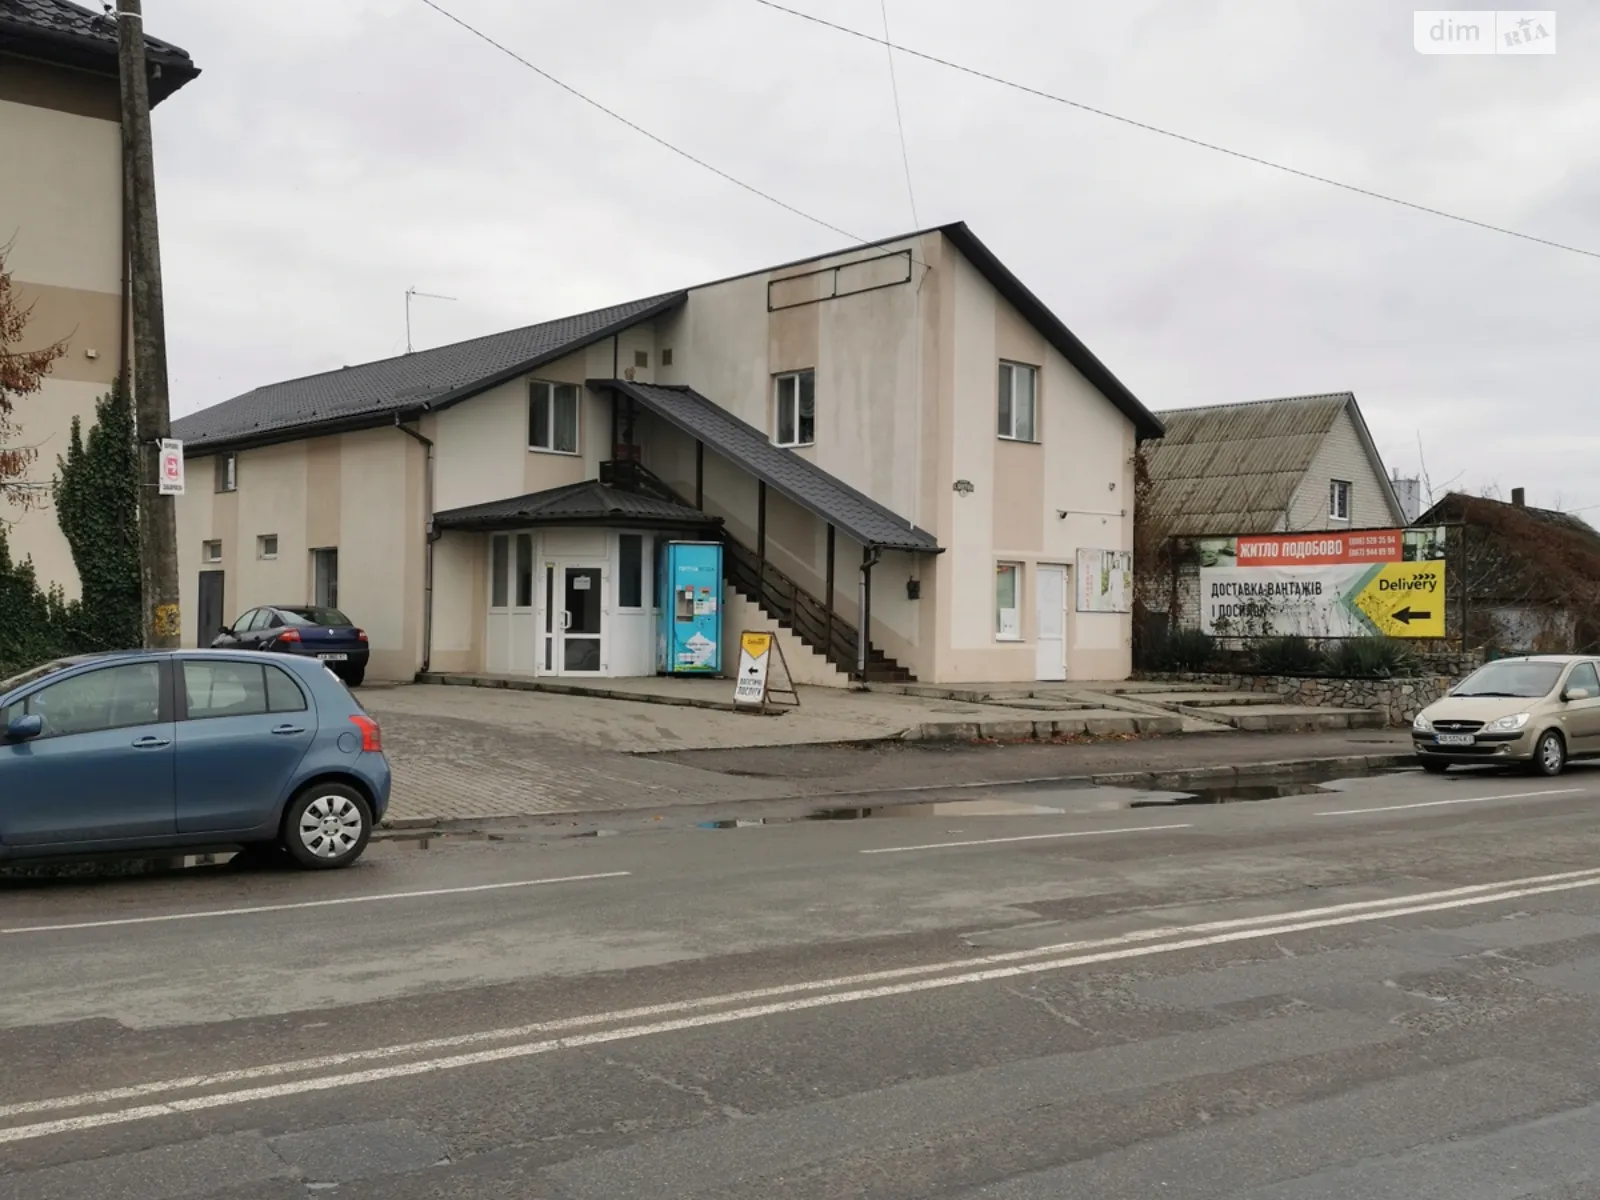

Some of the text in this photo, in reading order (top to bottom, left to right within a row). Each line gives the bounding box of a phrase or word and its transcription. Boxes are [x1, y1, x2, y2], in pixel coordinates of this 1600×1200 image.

[1240, 539, 1343, 559] ЖИТЛО ПОДОБОВО
[1211, 581, 1322, 598] ДОСТАВКА ВАНТАЖІВ
[1379, 577, 1437, 593] Delivery
